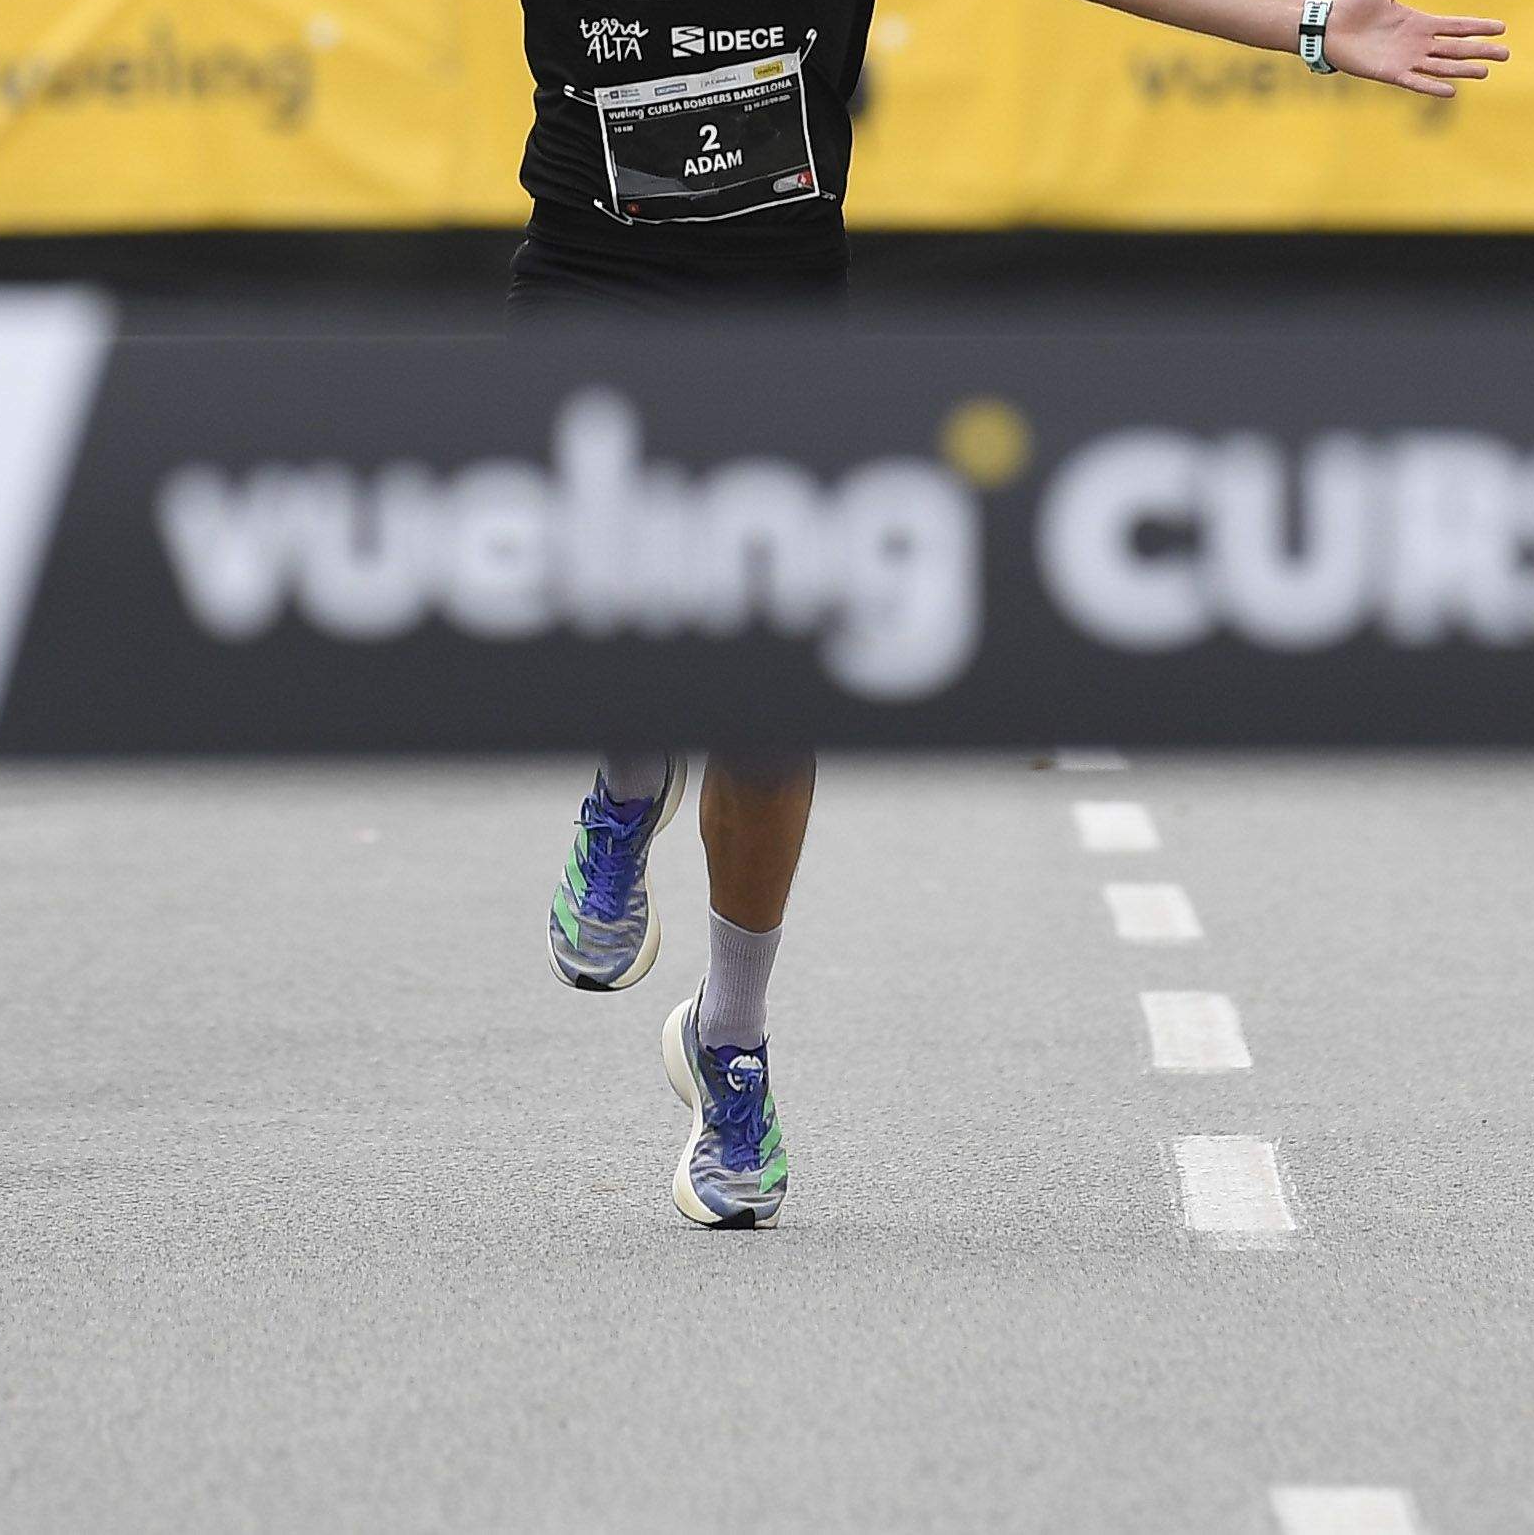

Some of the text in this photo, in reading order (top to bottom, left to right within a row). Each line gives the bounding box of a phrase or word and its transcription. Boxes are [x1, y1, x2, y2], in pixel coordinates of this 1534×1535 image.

[579, 18, 649, 39] terra
[709, 26, 785, 52] IDECE
[586, 34, 643, 64] ALTA
[647, 102, 683, 117] CURSA
[683, 93, 732, 110] BOMBERS
[733, 79, 793, 101] BARCELONA
[698, 124, 721, 152] 2
[684, 149, 743, 177] ADAM
[160, 388, 979, 699] vueling
